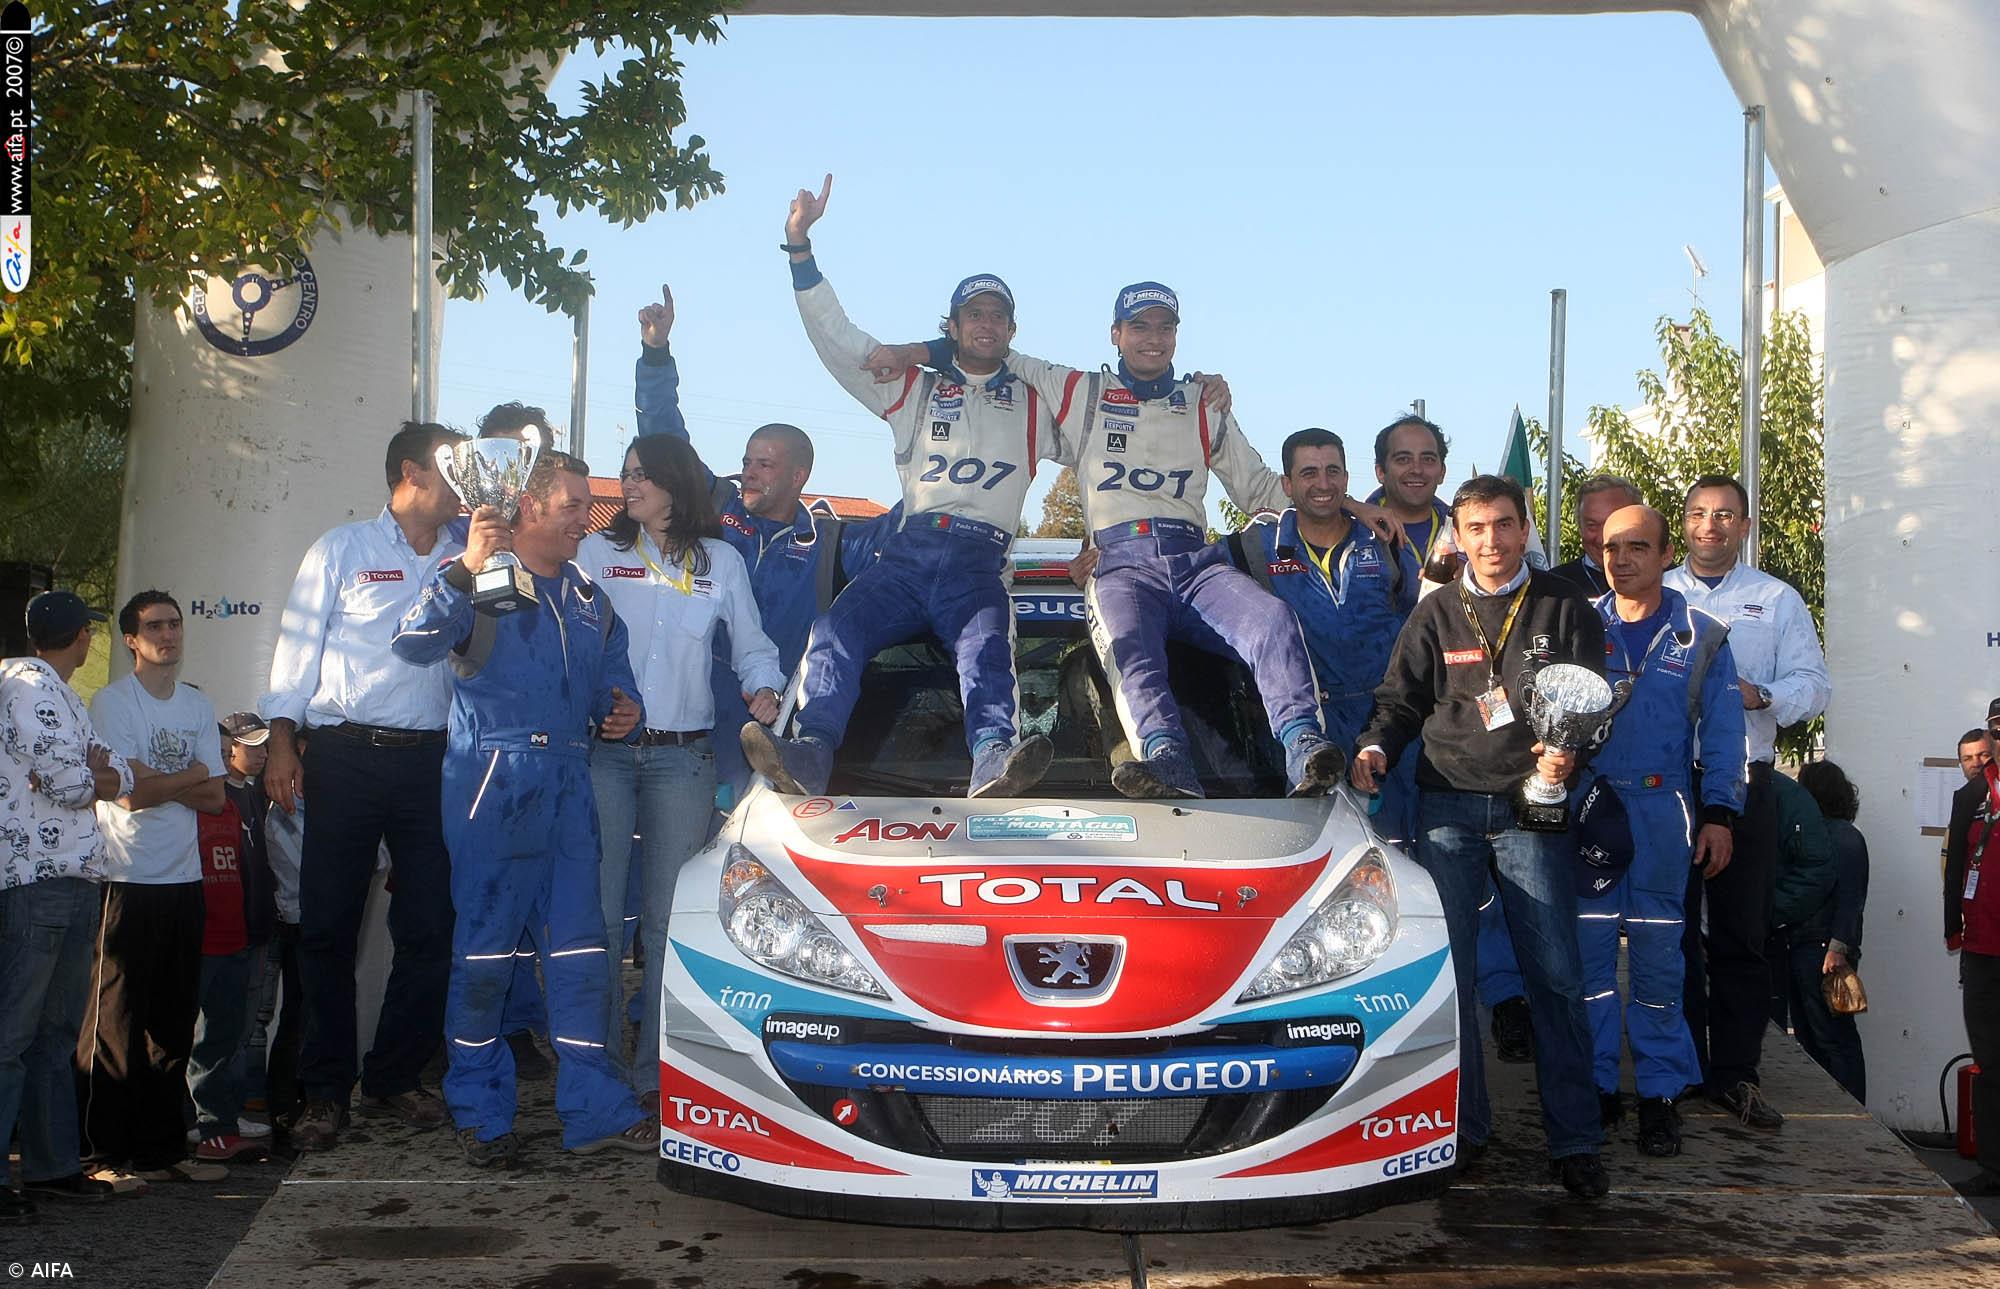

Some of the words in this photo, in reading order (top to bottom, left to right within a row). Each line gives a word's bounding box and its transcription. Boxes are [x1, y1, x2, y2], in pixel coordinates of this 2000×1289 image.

[295, 271, 315, 329] CENTRO
[1136, 291, 1175, 306] MICHELIN
[1107, 391, 1134, 401] TOTAL
[1110, 435, 1122, 447] LA
[920, 454, 1017, 490] 207
[1097, 461, 1193, 499] 207
[722, 514, 751, 536] TOTAL
[371, 572, 402, 580] TOTAL
[614, 567, 643, 576] TOTAL
[1269, 564, 1307, 573] TOTAL
[1448, 652, 1483, 662] TOTAL
[1586, 785, 1600, 810] 207
[1062, 809, 1070, 817] 1
[832, 818, 959, 844] AON
[212, 846, 237, 871] 62
[919, 872, 1220, 911] TOTAL
[720, 985, 773, 1010] tmn
[1354, 992, 1410, 1013] tmn
[766, 1015, 840, 1040] imageup
[1287, 1022, 1360, 1040] imageup
[857, 1063, 1063, 1085] CONCESSIONÁRIOS
[1073, 1059, 1276, 1092] PEUGEOT
[668, 1096, 771, 1137] TOTAL
[969, 1097, 1150, 1148] 207
[1359, 1109, 1453, 1141] TOTAL
[662, 1138, 741, 1172] GEFCO
[1382, 1143, 1455, 1177] GEFCO
[1014, 1174, 1156, 1191] MICHELIN
